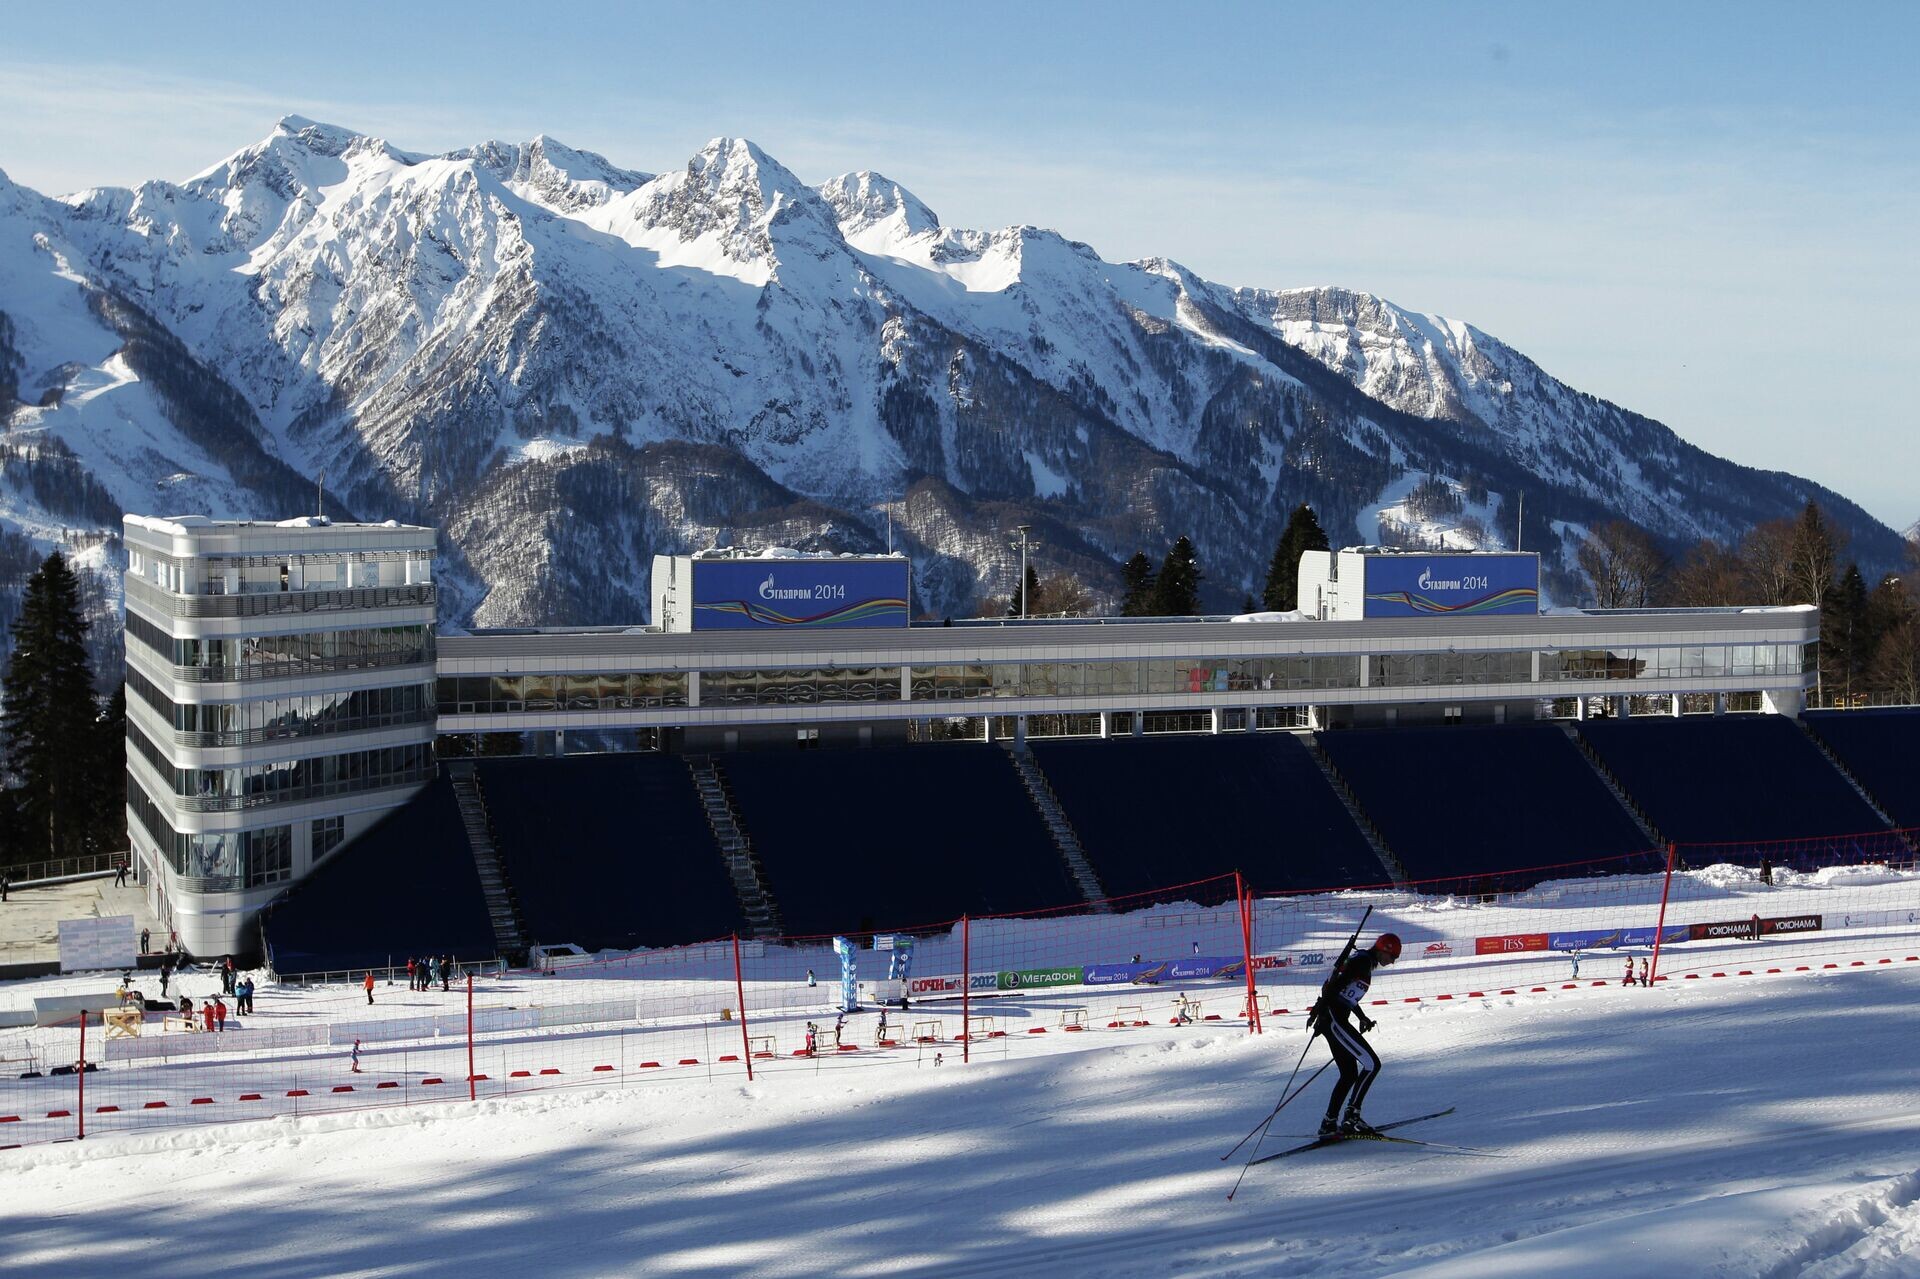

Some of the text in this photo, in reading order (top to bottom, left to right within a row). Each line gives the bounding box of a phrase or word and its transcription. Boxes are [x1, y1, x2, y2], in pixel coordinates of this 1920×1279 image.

[1463, 576, 1488, 590] 2014
[774, 585, 845, 600] ГАЗПРОМ 2014
[1707, 925, 1751, 936] YOKOHAMA
[1775, 920, 1817, 930] YOKOHAMA
[1503, 937, 1524, 950] TESS
[1300, 953, 1324, 965] 2012
[1113, 972, 1128, 981] 2014
[1195, 967, 1210, 975] 2014
[912, 975, 997, 993] СОЧИ 2012
[1022, 972, 1076, 984] МЕГАФОН
